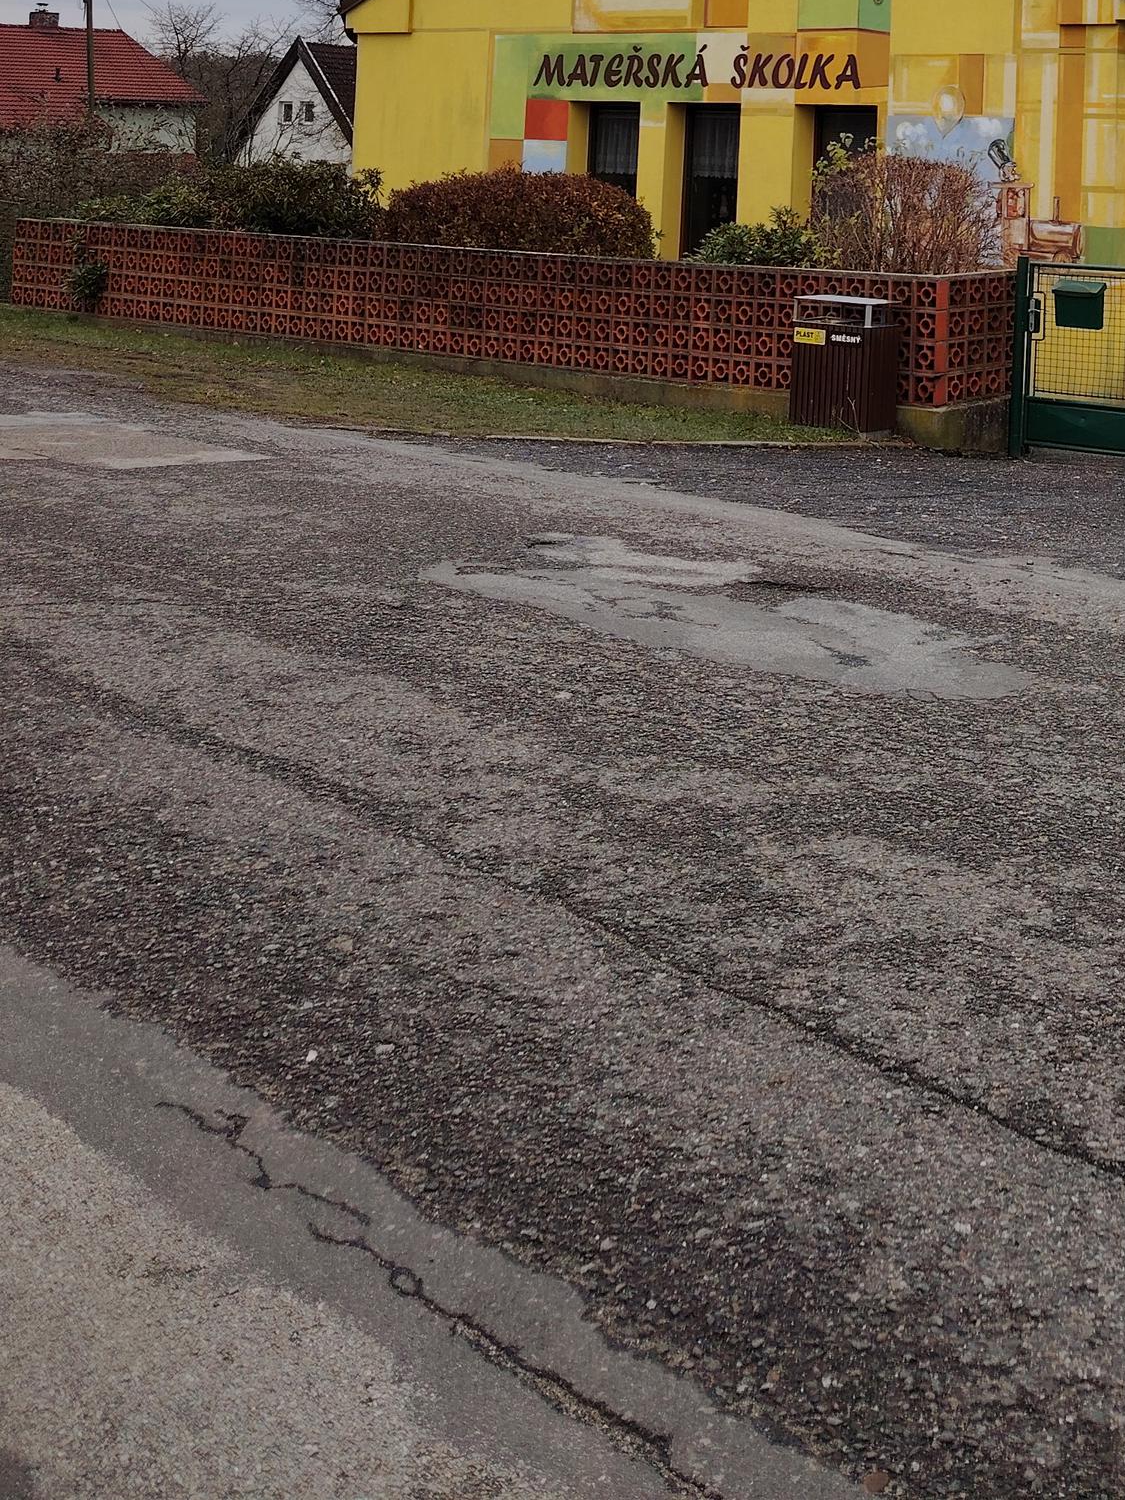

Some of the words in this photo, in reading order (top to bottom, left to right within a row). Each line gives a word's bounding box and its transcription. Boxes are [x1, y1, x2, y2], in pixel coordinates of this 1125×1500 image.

[532, 43, 709, 89] MATEŘSKÁ
[729, 44, 862, 91] ŠKOLKA
[795, 330, 815, 339] PLAST
